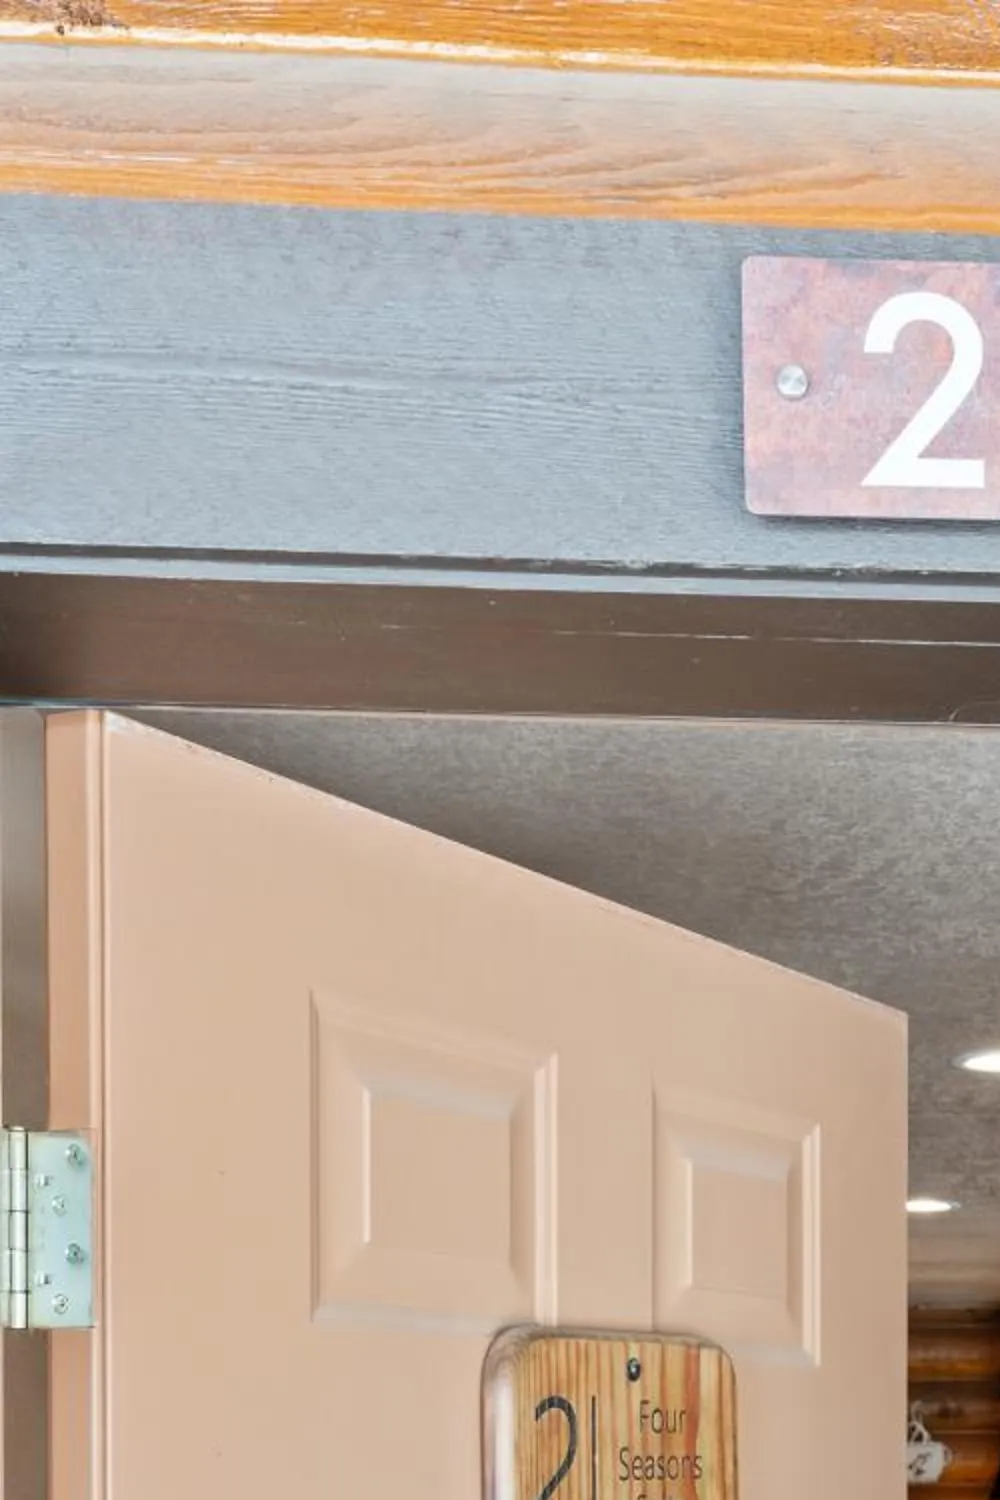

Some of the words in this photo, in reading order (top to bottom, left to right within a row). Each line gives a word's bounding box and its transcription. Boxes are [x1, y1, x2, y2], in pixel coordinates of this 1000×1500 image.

[860, 291, 985, 488] 2
[638, 1399, 687, 1434] Four
[618, 1446, 703, 1482] Seasons
